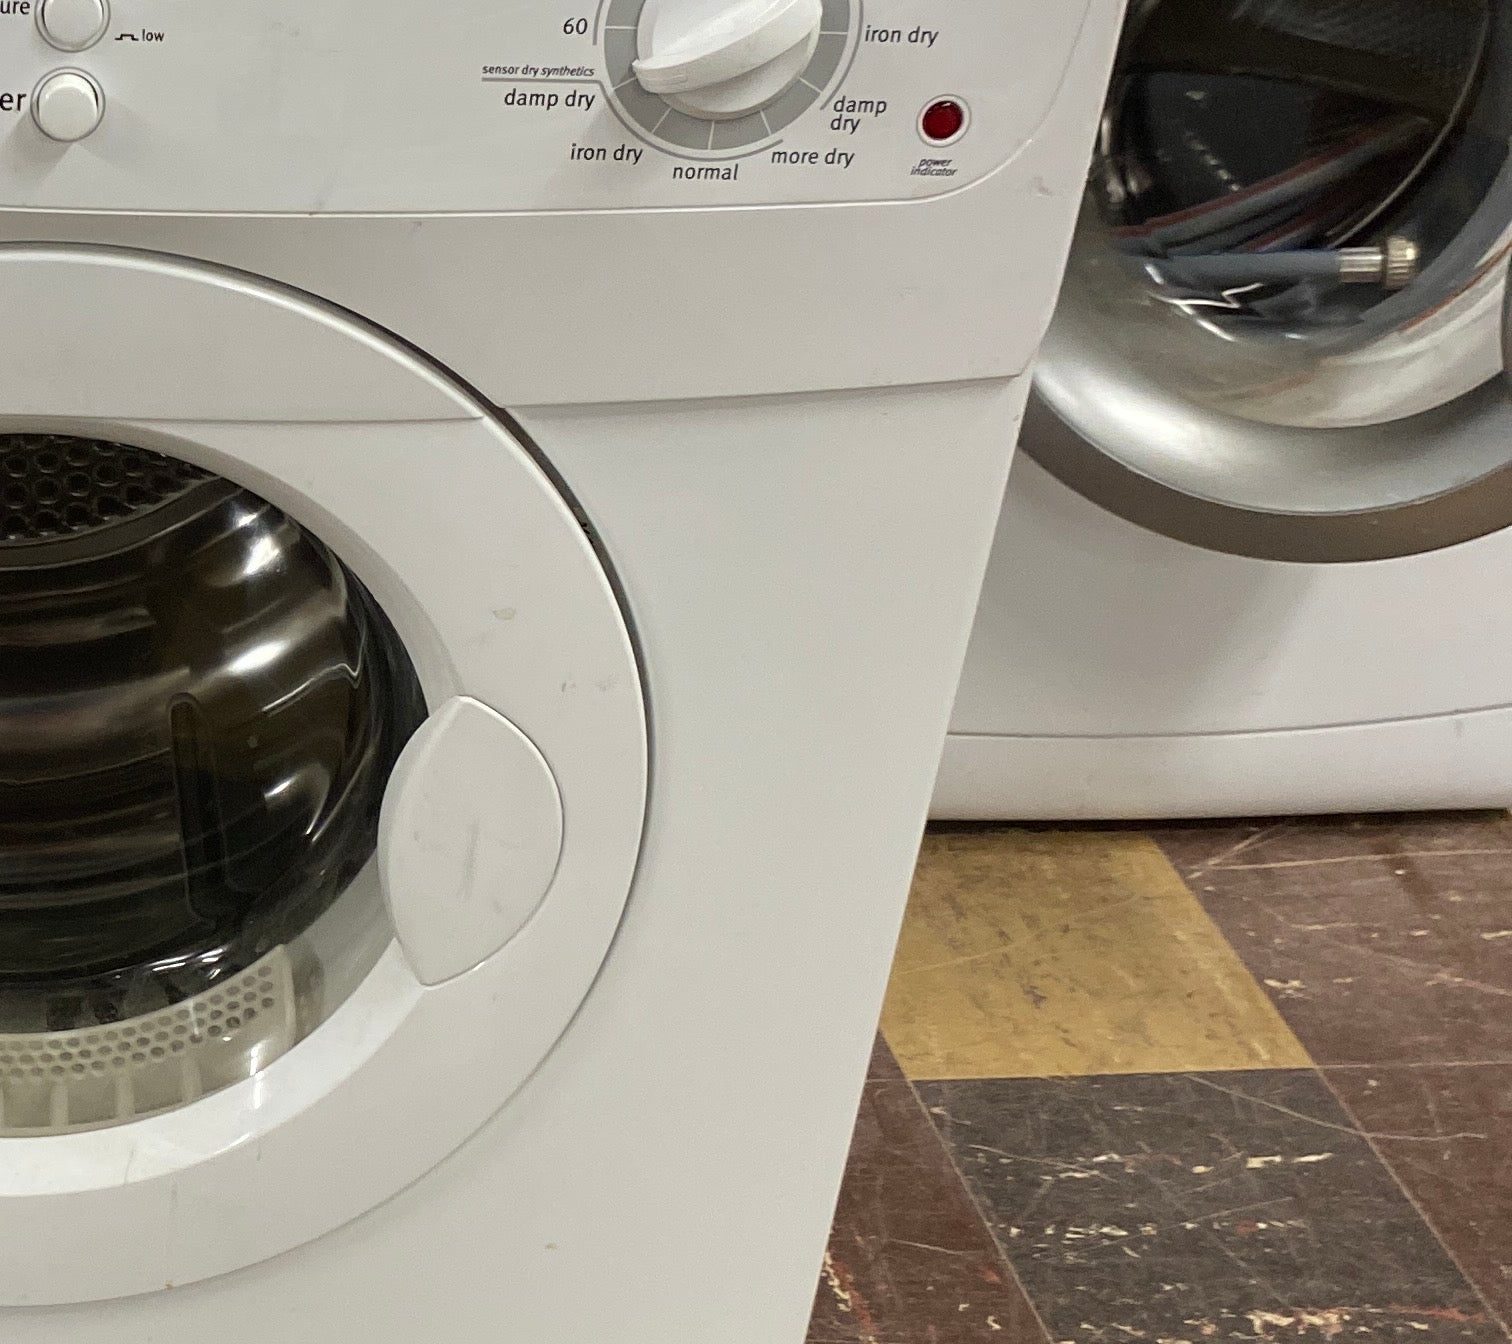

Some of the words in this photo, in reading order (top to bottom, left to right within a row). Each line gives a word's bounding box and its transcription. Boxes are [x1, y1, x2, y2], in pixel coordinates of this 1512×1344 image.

[142, 29, 164, 42] low
[563, 17, 588, 36] 60
[865, 25, 904, 44] iron
[908, 25, 939, 48] dry
[482, 65, 520, 75] sensor
[521, 65, 539, 77] dry
[541, 66, 595, 77] synthetics
[504, 88, 559, 111] damp
[565, 90, 596, 111] dry
[833, 96, 887, 117] damp
[830, 114, 861, 135] dry
[570, 143, 607, 160] iron
[613, 144, 643, 165] dry
[771, 151, 819, 165] more
[824, 148, 855, 169] dry
[918, 158, 952, 168] power
[673, 163, 739, 182] normal
[910, 166, 958, 176] indicator
